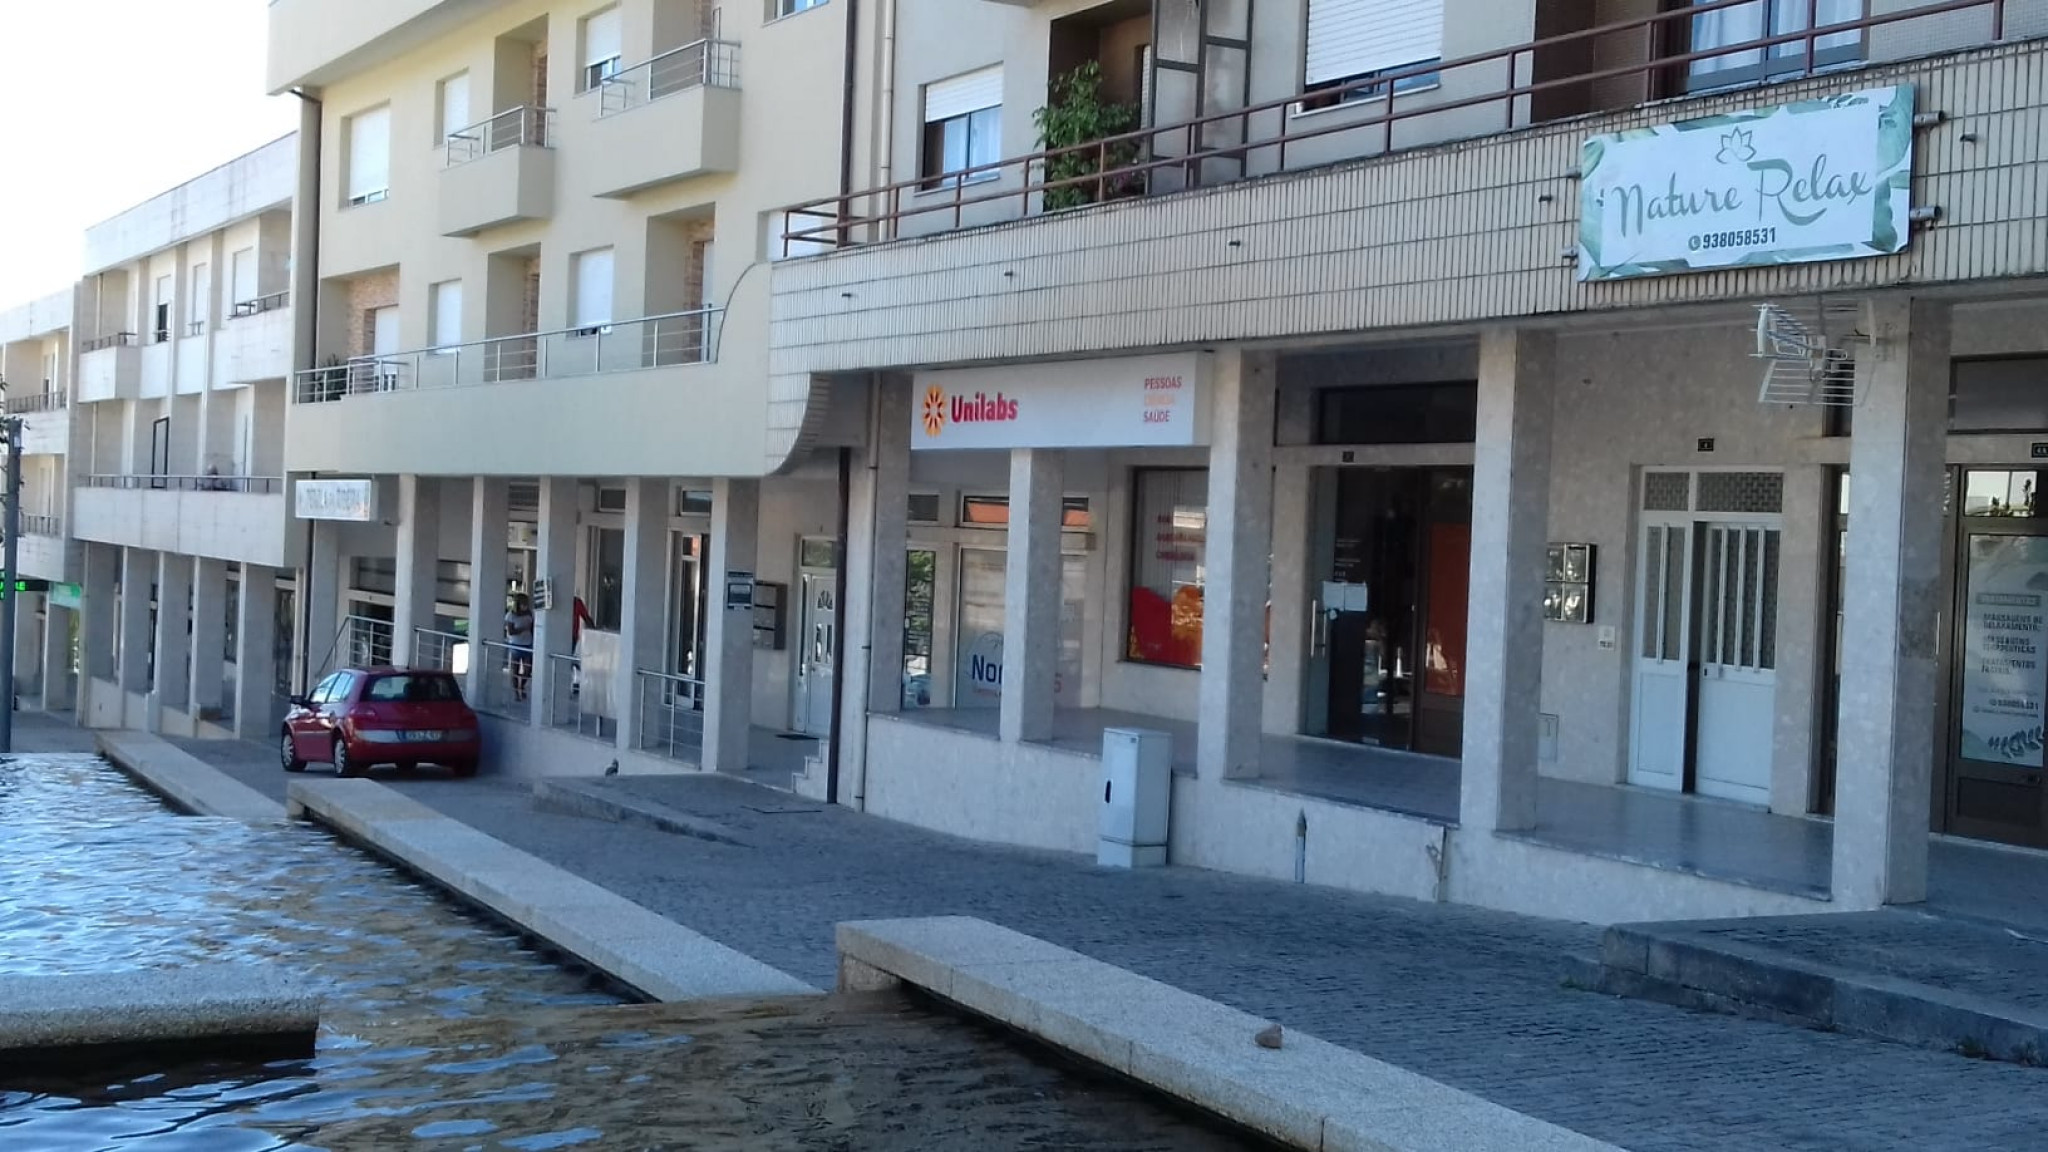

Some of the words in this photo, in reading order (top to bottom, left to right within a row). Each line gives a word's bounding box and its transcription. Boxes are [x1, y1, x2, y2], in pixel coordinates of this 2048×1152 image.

[1612, 171, 1742, 238] Nature
[1747, 153, 1875, 227] Relax
[1703, 227, 1777, 250] 938058531
[1143, 376, 1183, 390] PESSOAS
[950, 391, 1019, 423] Unilabs
